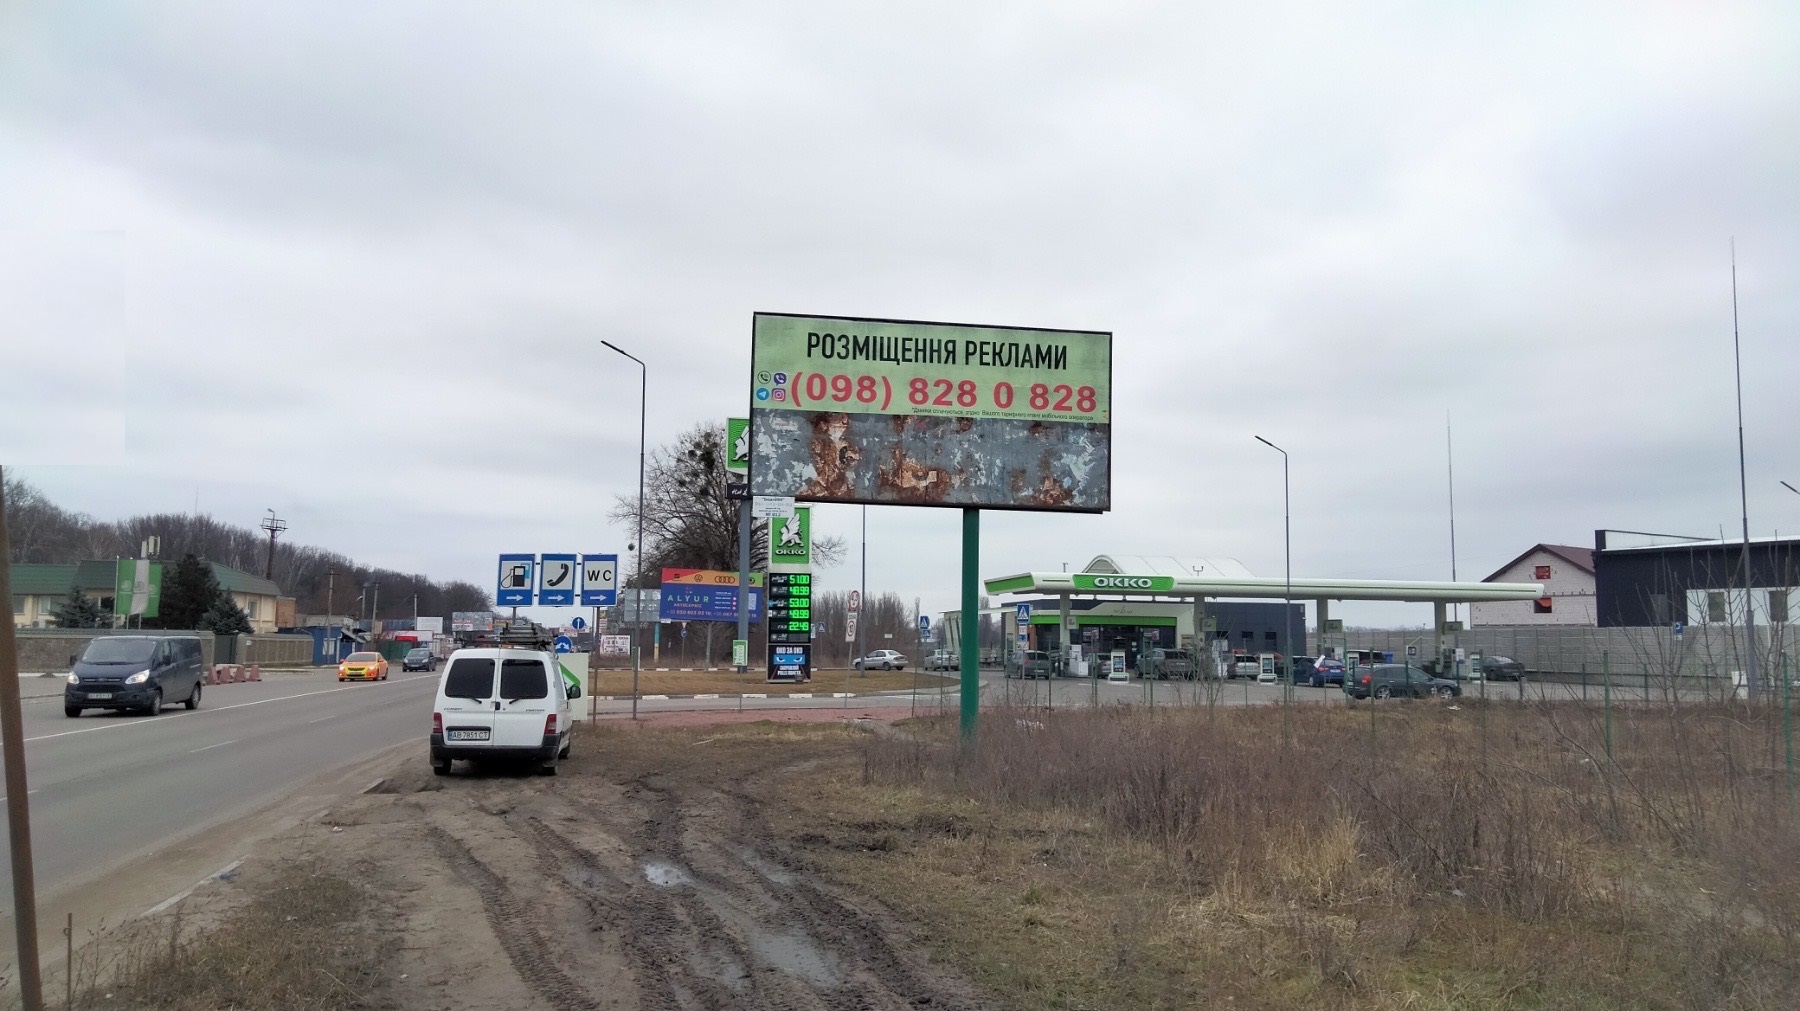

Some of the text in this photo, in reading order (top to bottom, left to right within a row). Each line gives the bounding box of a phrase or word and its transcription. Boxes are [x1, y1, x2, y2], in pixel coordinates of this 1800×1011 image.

[807, 332, 1068, 371] РОЗМІЩЕННЯ РЕКЛАМИ
[791, 371, 1098, 413] (098) 828 0 828
[587, 570, 612, 582] WC
[1094, 577, 1152, 588] OKKO
[667, 594, 709, 603] ALYUR
